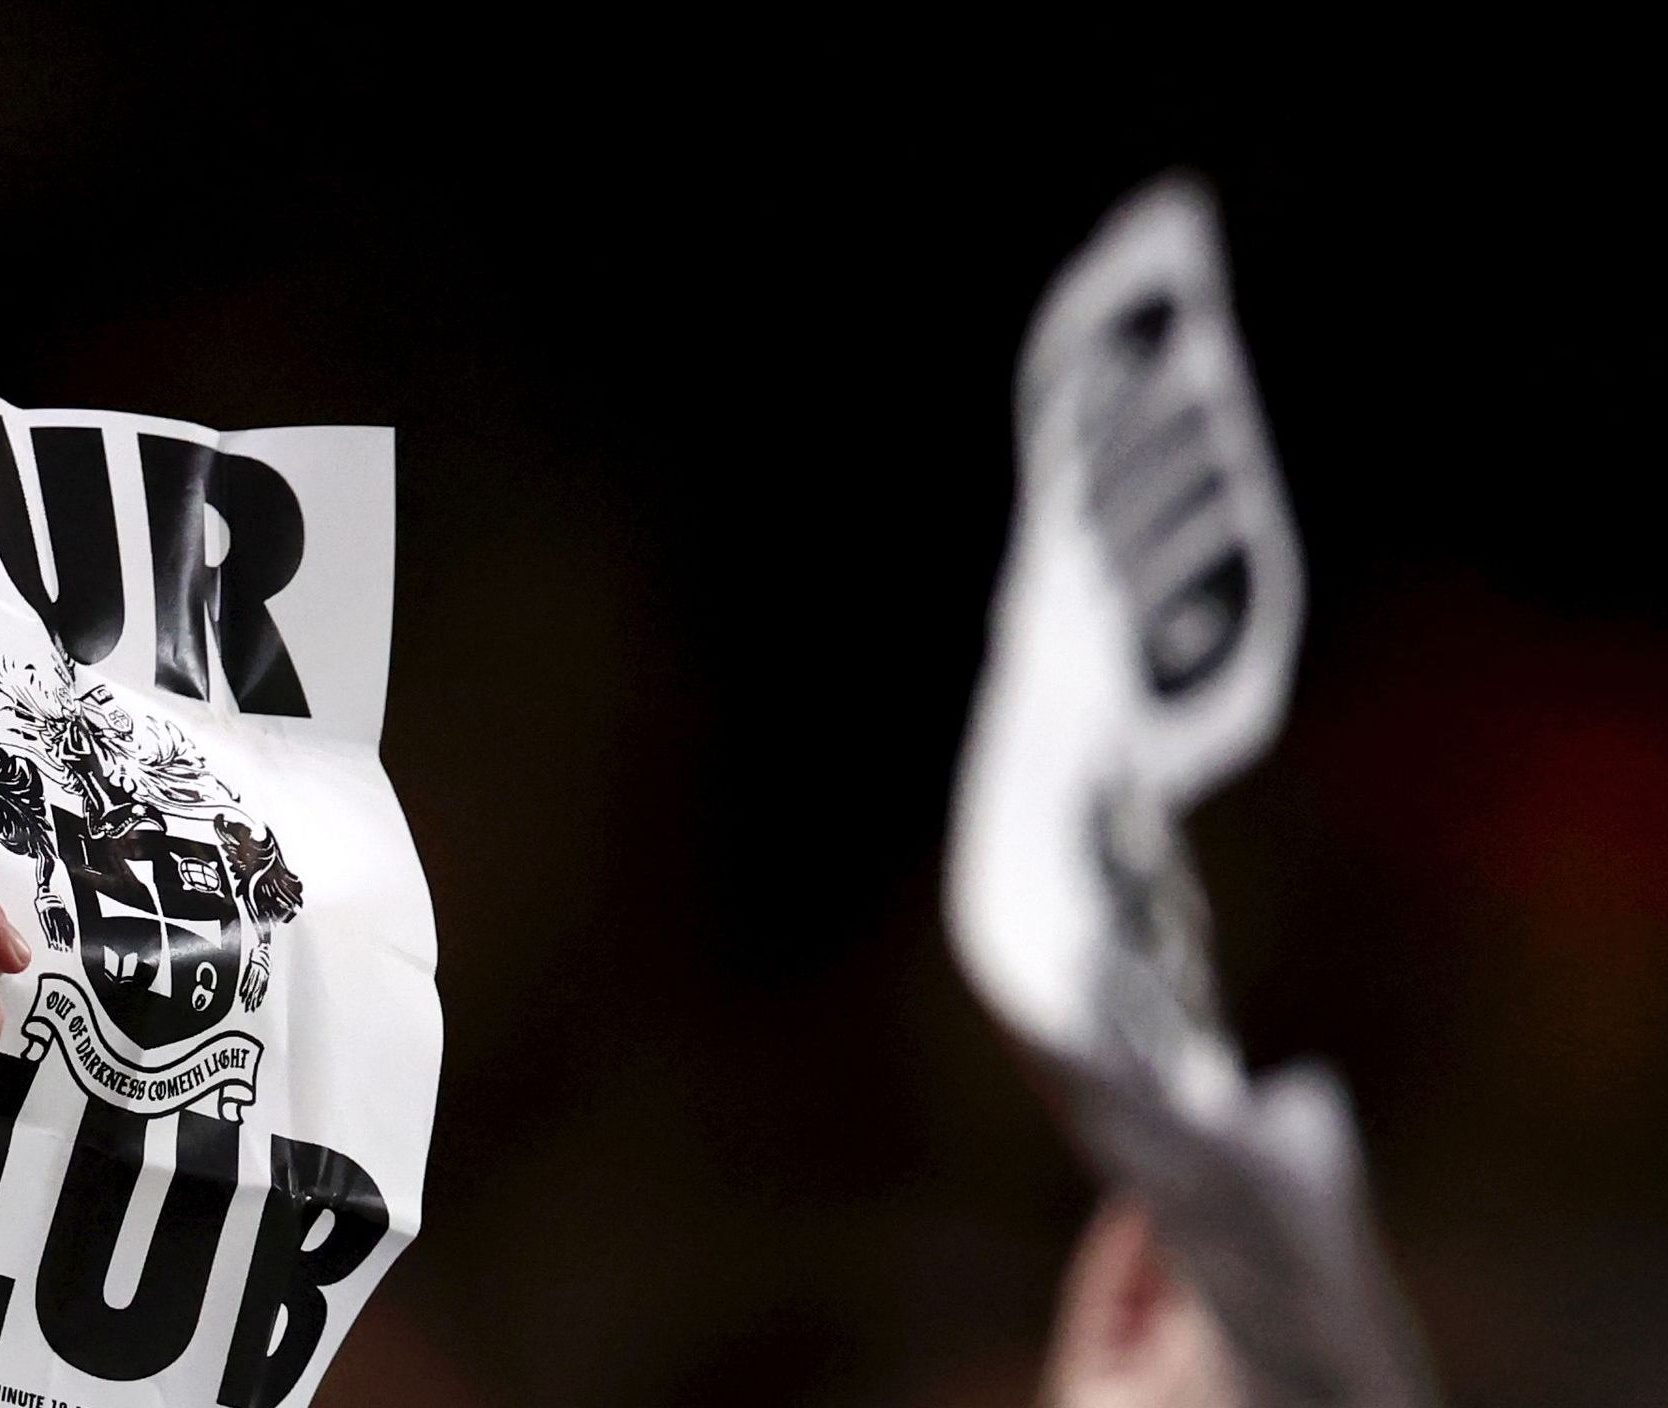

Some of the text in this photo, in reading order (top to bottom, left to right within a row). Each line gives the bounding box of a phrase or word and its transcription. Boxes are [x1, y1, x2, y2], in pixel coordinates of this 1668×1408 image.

[46, 991, 250, 1101] OUT OF DARKNESS COMETH LIGHT
